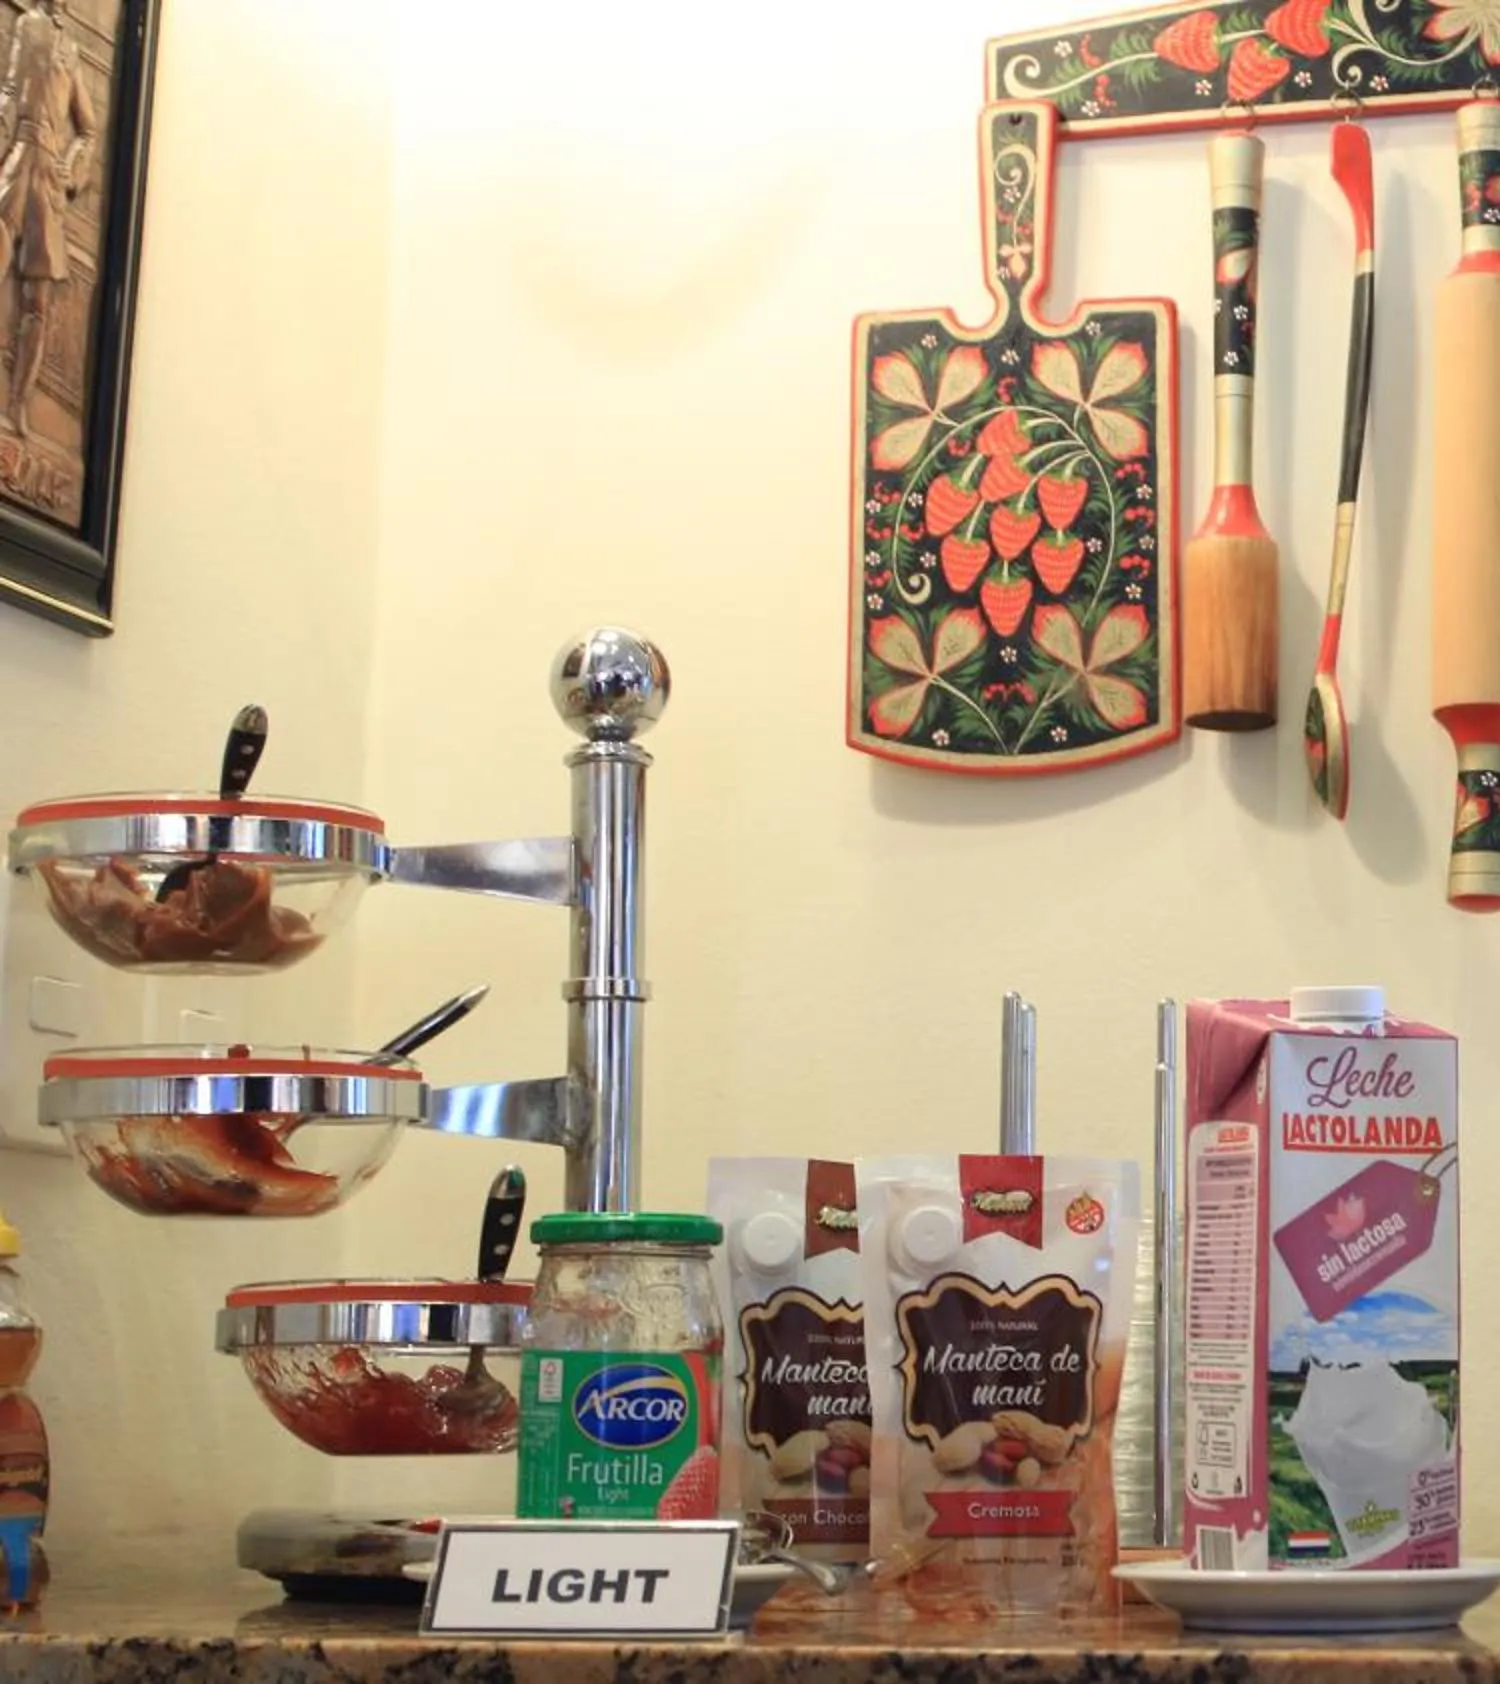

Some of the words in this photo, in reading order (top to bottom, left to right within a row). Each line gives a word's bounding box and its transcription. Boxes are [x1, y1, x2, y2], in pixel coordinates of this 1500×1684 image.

[1306, 1046, 1415, 1109] Leche
[1283, 1113, 1443, 1153] LACTOLANDA
[1316, 1251, 1345, 1284] sin
[1343, 1212, 1408, 1268] lactosa
[923, 1342, 1043, 1375] Manteca
[1050, 1343, 1082, 1374] de
[577, 1388, 685, 1422] ARCOR
[972, 1378, 1047, 1407] maní
[566, 1452, 664, 1486] Frutilla
[597, 1486, 630, 1504] Light
[966, 1502, 1041, 1520] Cremosa
[491, 1568, 670, 1604] LIGHT
